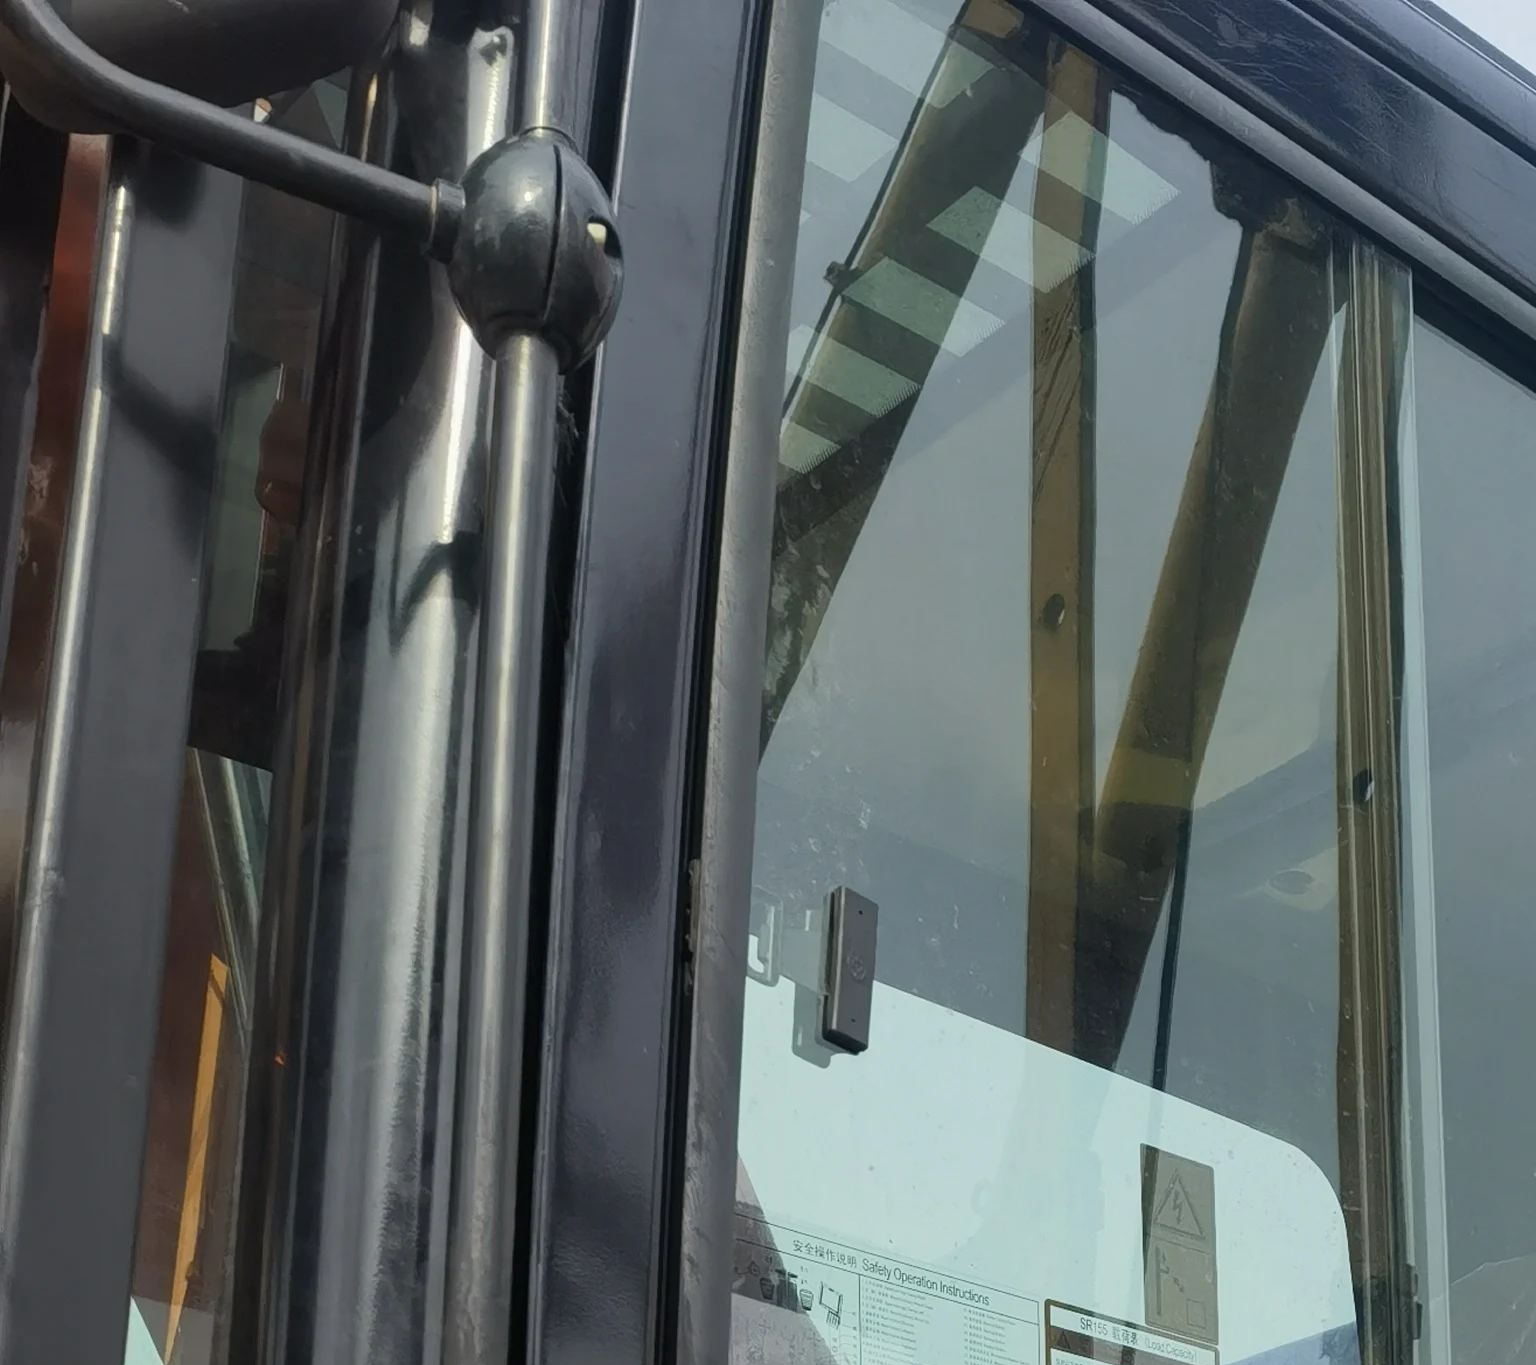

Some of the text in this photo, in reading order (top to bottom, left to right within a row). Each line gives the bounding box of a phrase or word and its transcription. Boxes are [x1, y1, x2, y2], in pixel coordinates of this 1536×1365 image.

[793, 1239, 990, 1307] 安全操作说明 Safety Operation Instructions
[1079, 1316, 1109, 1336] SR155
